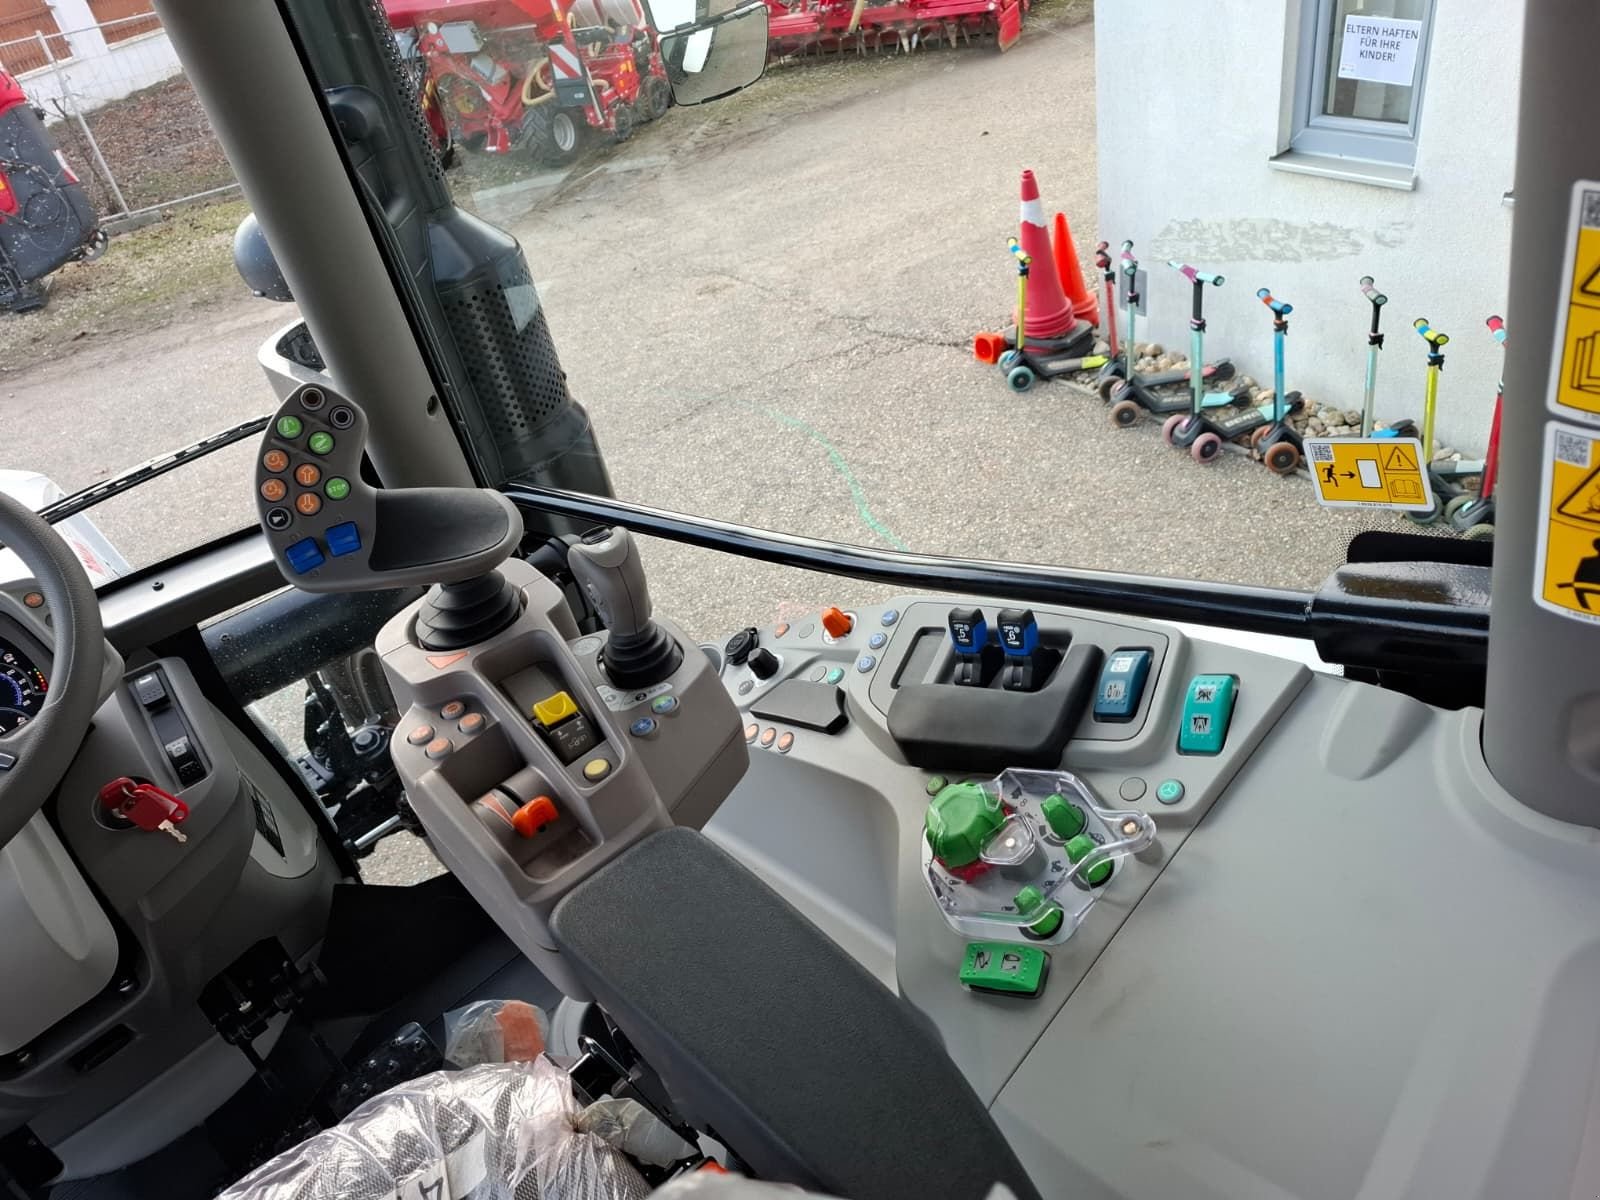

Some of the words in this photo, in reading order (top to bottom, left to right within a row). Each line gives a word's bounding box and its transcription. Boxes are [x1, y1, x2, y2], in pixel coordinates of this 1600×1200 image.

[1346, 24, 1380, 36] ELTERN
[1382, 27, 1419, 39] HAFTEN
[1360, 36, 1378, 48] FÜR
[1380, 39, 1401, 50] IHRE
[1360, 50, 1396, 62] KINDER!
